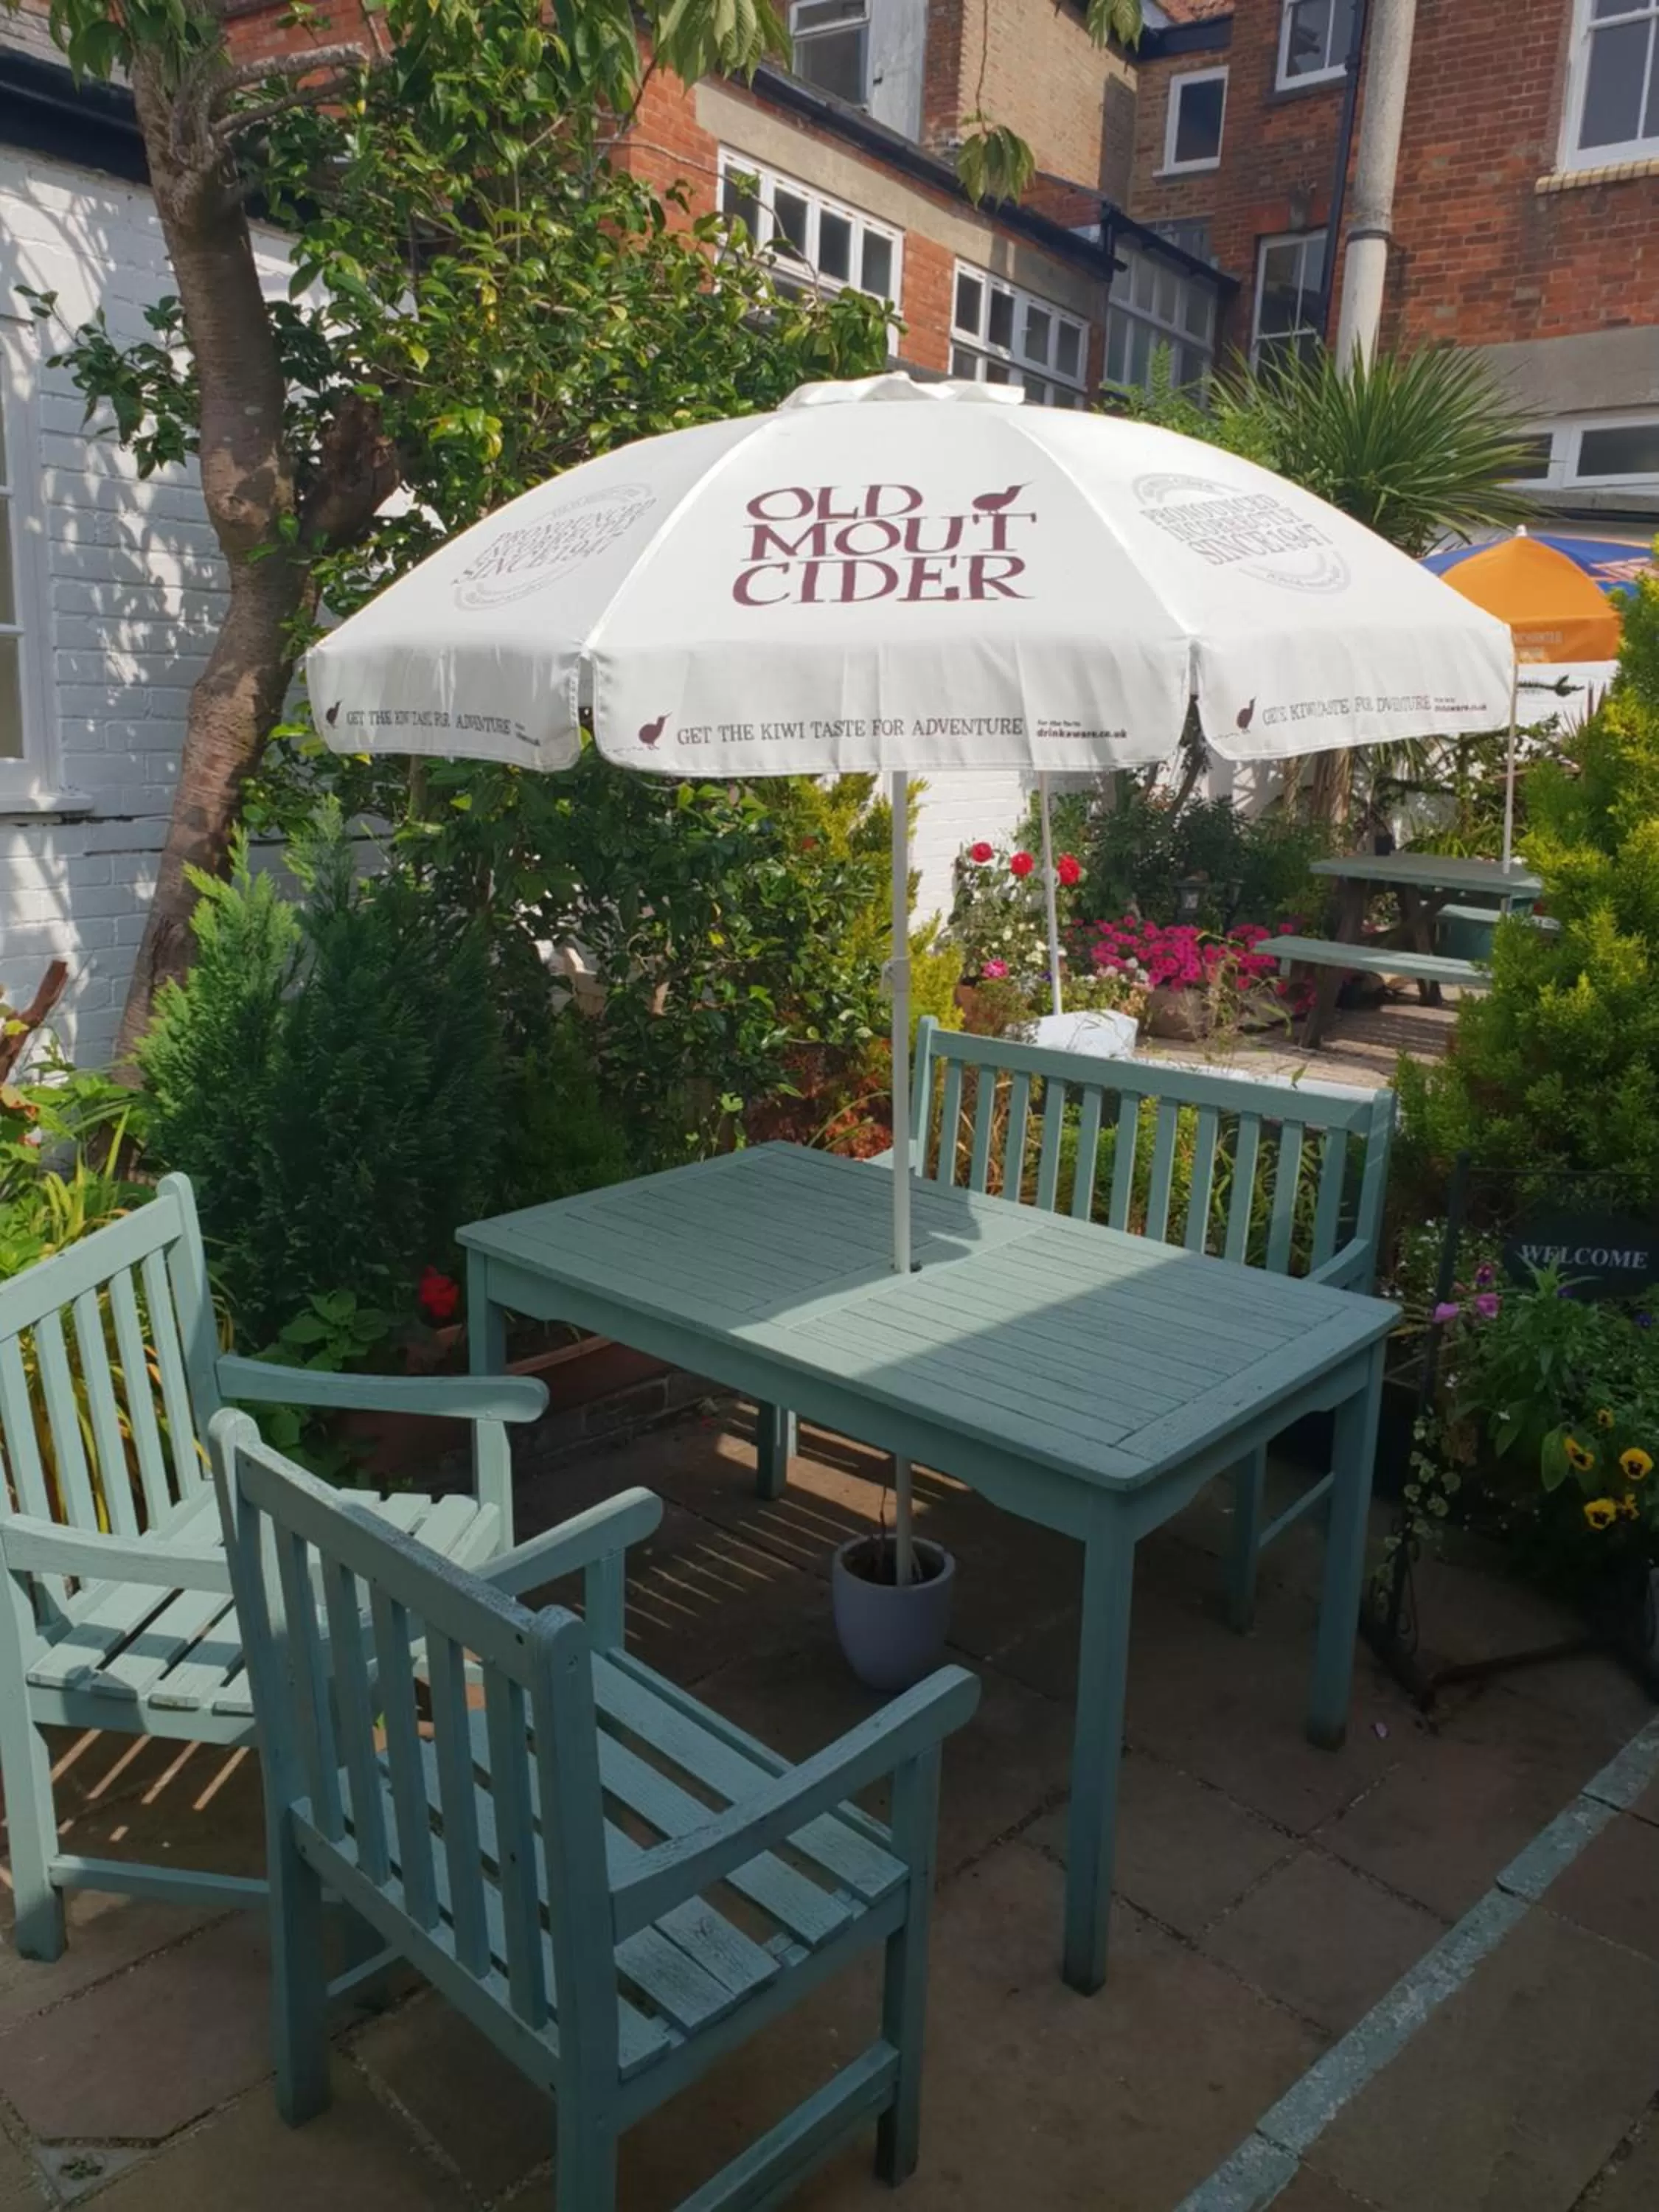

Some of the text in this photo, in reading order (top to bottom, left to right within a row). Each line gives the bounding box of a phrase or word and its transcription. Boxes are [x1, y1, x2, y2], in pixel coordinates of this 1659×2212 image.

[746, 484, 923, 521] OLD
[740, 513, 1037, 562] MOUT
[732, 554, 1036, 606] CIDER
[678, 717, 1023, 745] GET THE KIWI TASTE FOR ADVENTURE
[1521, 1244, 1649, 1269] WELCOME
